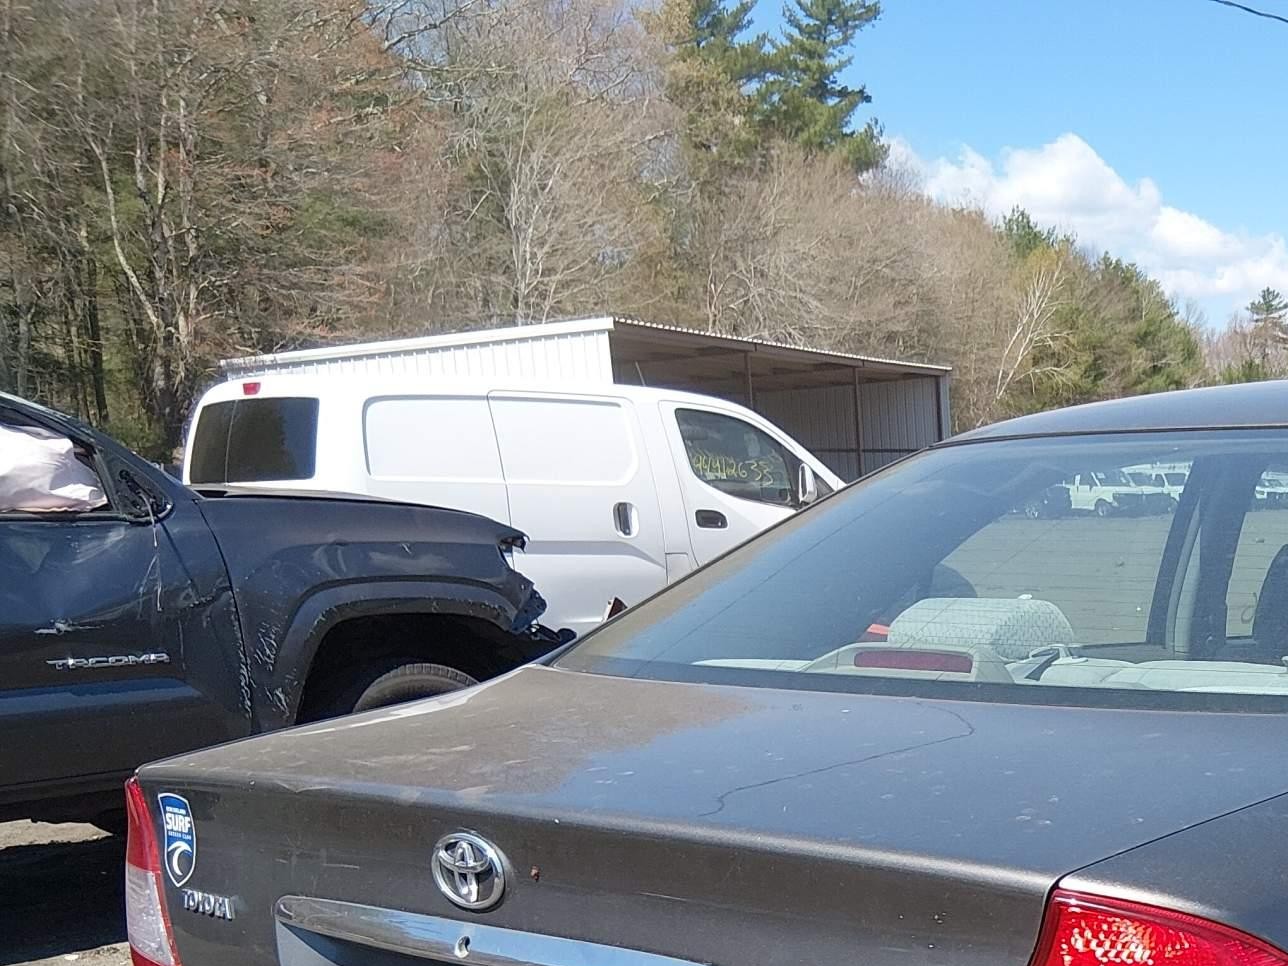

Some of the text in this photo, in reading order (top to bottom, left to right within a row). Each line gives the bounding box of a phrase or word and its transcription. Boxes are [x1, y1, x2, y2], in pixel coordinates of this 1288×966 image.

[46, 652, 170, 670] TACOMA
[165, 812, 191, 833] SURF
[182, 887, 236, 919] TOYOTA
